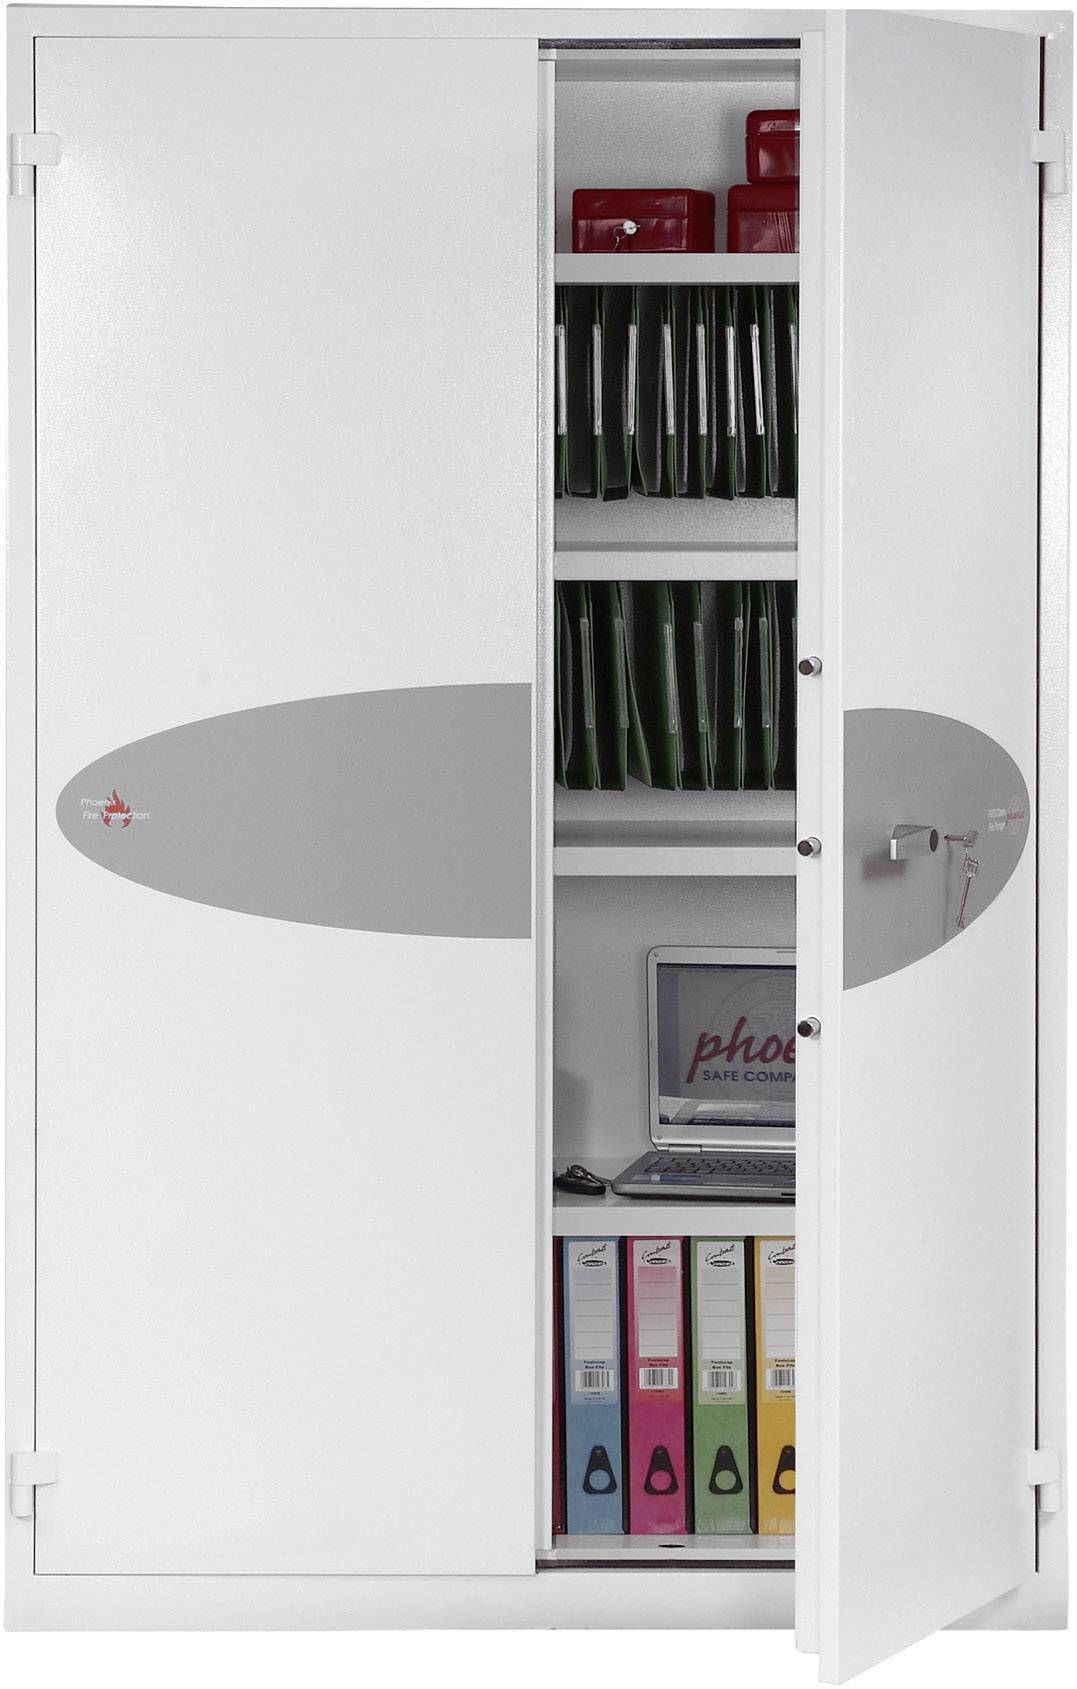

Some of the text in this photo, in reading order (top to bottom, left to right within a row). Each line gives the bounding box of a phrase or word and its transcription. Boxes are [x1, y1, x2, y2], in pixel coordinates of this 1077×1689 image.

[80, 798, 116, 807] Phoenix
[82, 811, 150, 820] Fire Protection
[703, 1070, 739, 1082] SAFE
